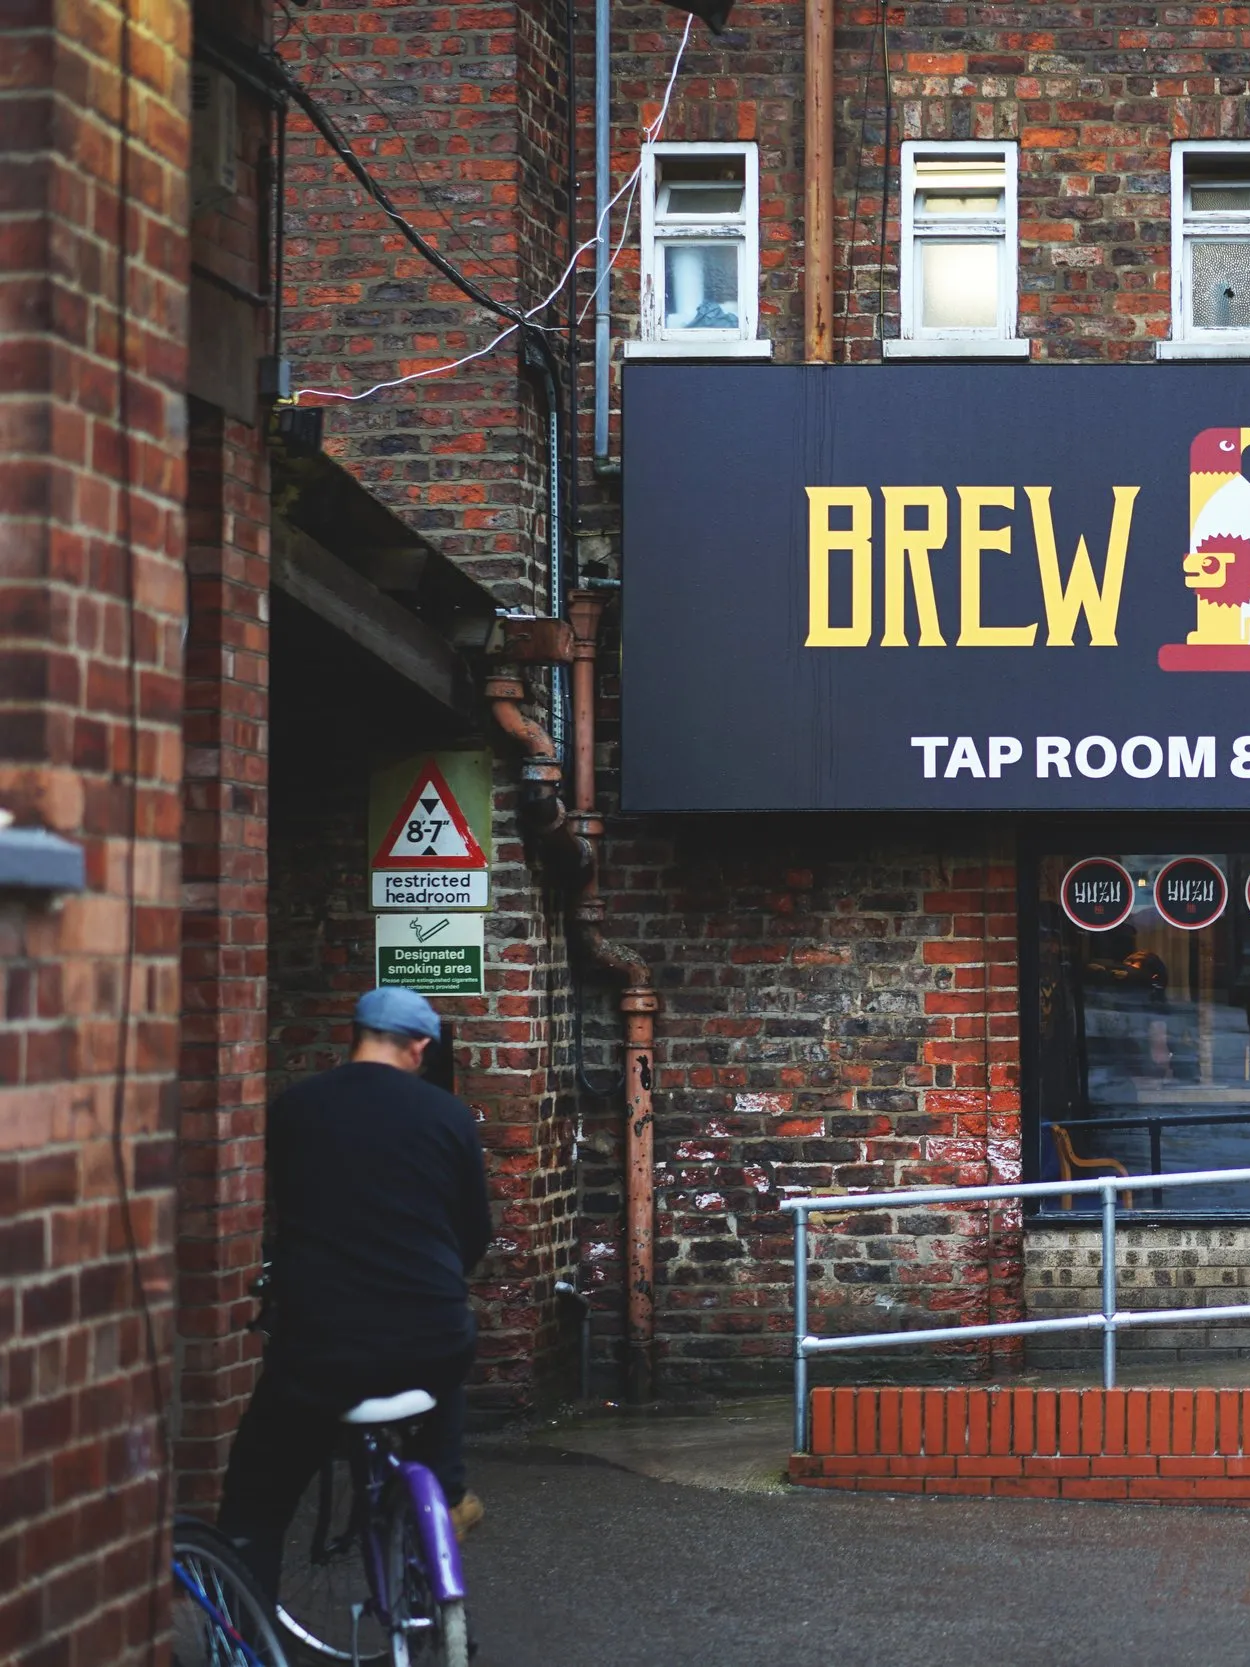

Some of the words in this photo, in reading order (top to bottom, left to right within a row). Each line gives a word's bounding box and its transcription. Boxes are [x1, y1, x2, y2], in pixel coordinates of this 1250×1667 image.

[804, 486, 1141, 647] BREW
[911, 736, 1023, 778] TAP
[1036, 735, 1216, 779] ROOM
[386, 873, 471, 887] restricted
[386, 888, 471, 903] headroom
[395, 949, 465, 962] Designated
[388, 963, 441, 976] smoking
[444, 964, 472, 974] area
